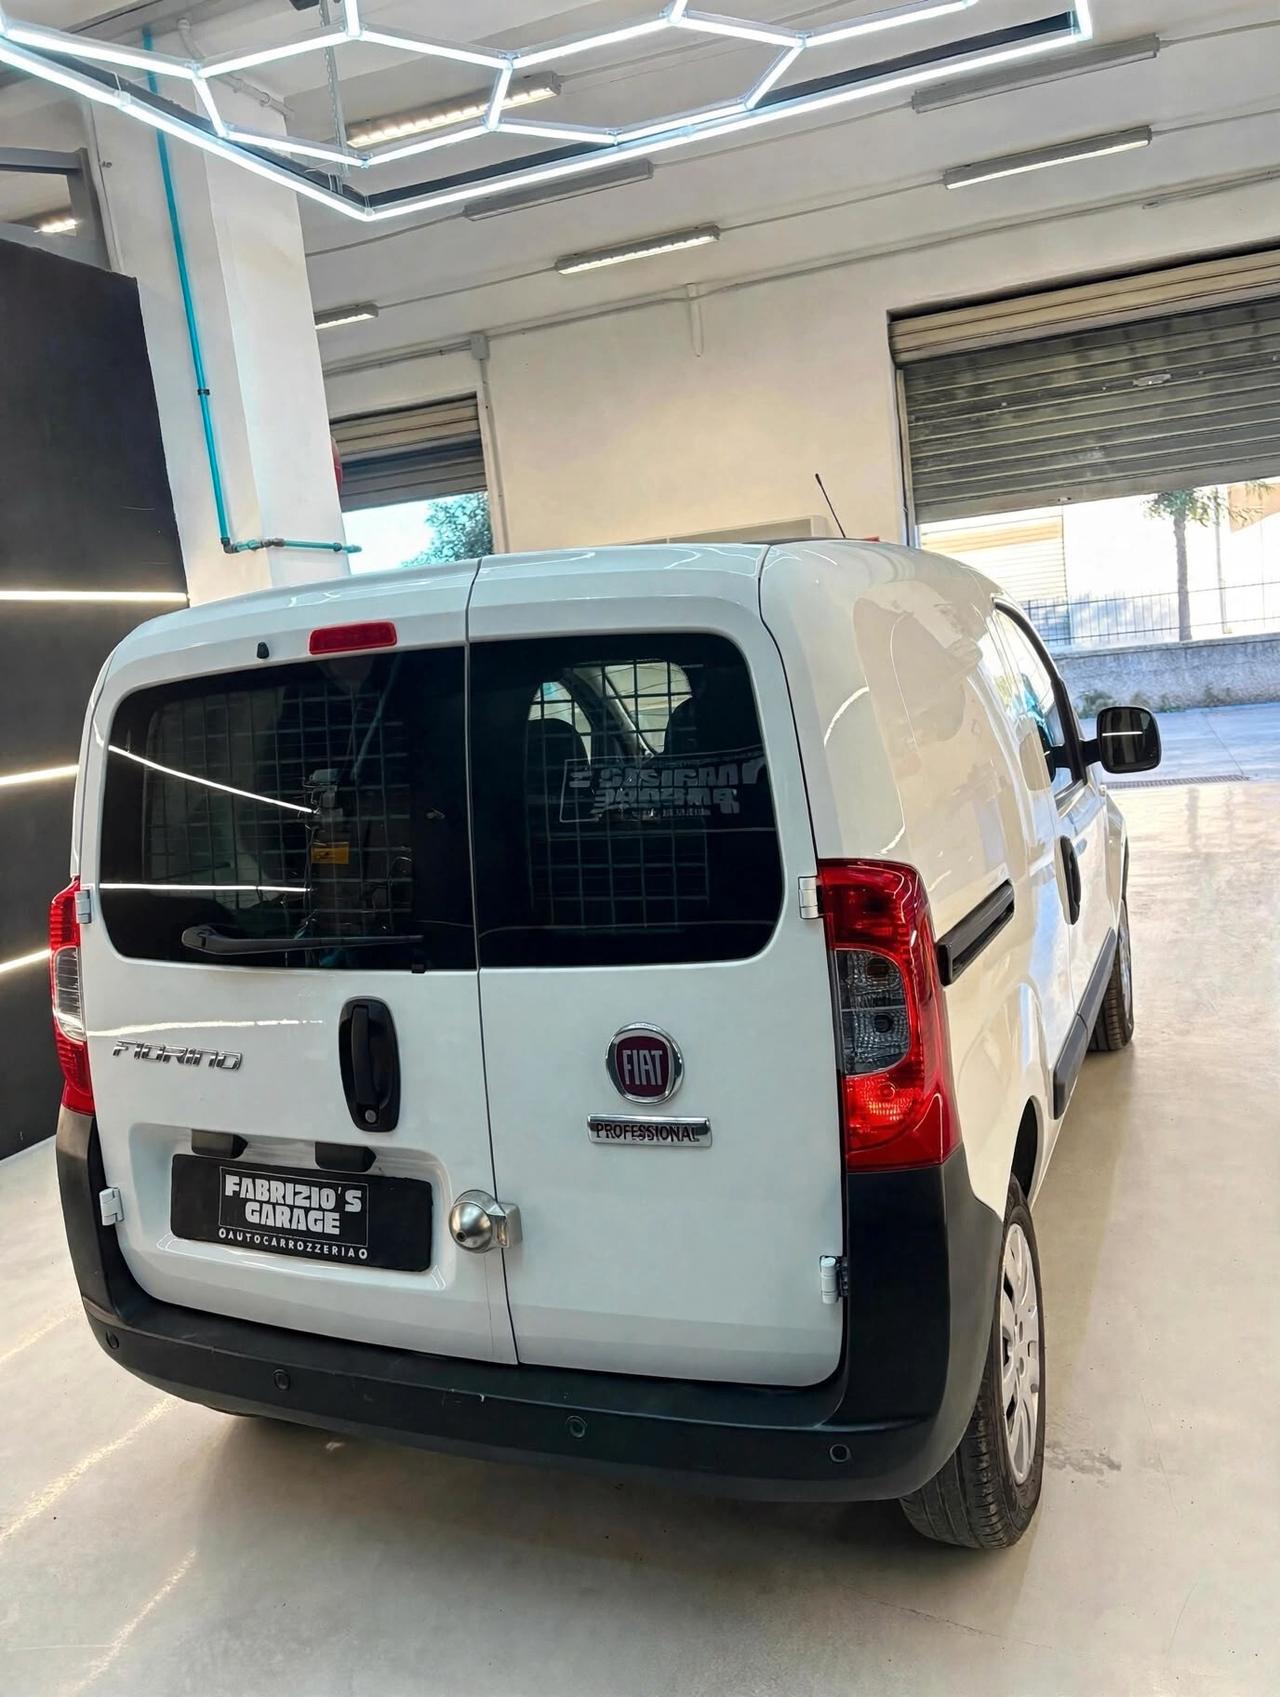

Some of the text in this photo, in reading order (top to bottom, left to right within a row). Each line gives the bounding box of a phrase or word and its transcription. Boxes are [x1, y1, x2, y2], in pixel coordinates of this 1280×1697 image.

[112, 1040, 243, 1070] FIORINO
[622, 1049, 663, 1085] FIAT
[596, 1123, 701, 1142] PROFESSIONAL
[225, 1174, 362, 1213] FABRIZIO'S
[245, 1202, 340, 1235] GARAGE
